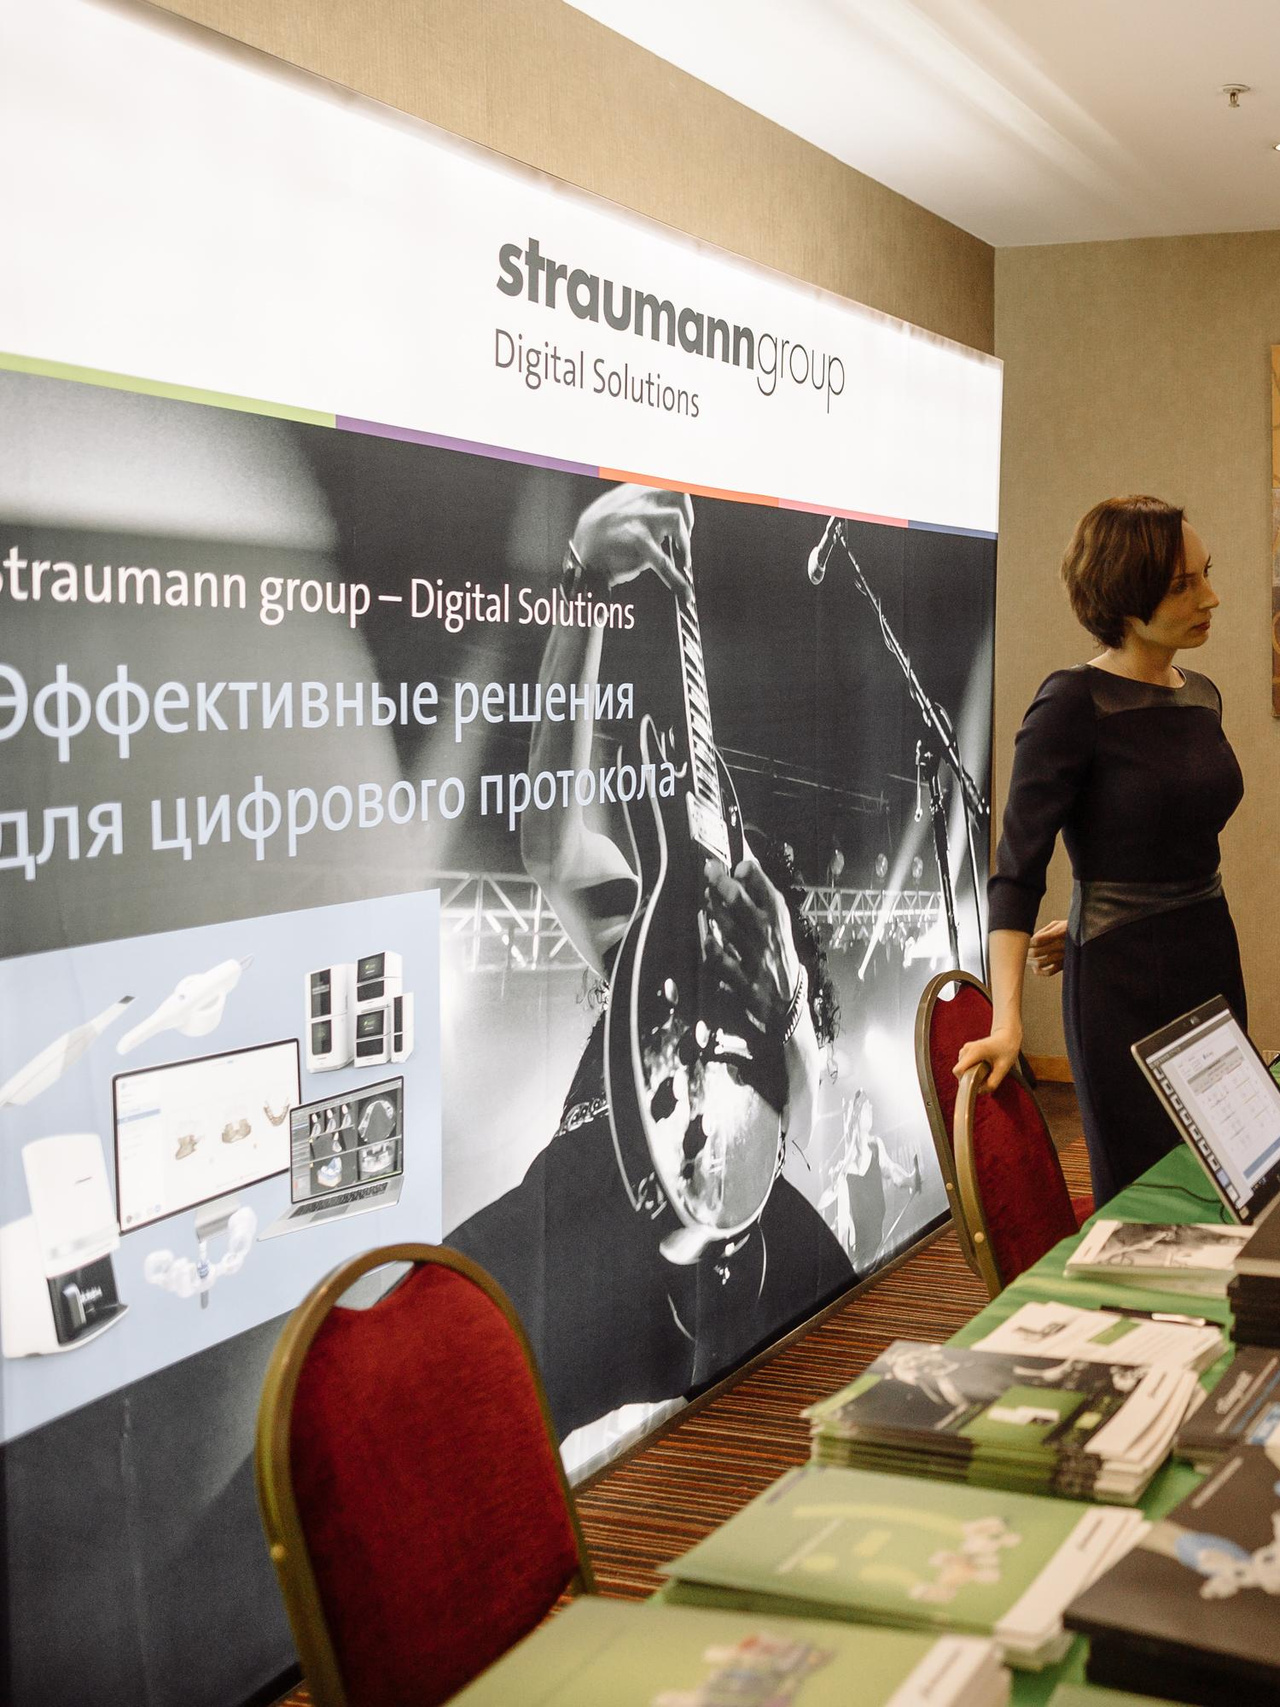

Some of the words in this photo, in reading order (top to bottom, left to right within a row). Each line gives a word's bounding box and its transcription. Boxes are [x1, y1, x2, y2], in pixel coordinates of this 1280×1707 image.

[495, 328, 585, 390] Digital
[593, 357, 700, 418] Solutions
[0, 545, 246, 610] traumann
[260, 574, 371, 629] group
[411, 578, 510, 633] Digital
[518, 586, 636, 630] Solutions
[0, 663, 439, 763] Эффективные
[454, 681, 635, 743] решения
[0, 802, 124, 881] для
[150, 775, 466, 861] цифрового
[480, 759, 676, 831] протокола
